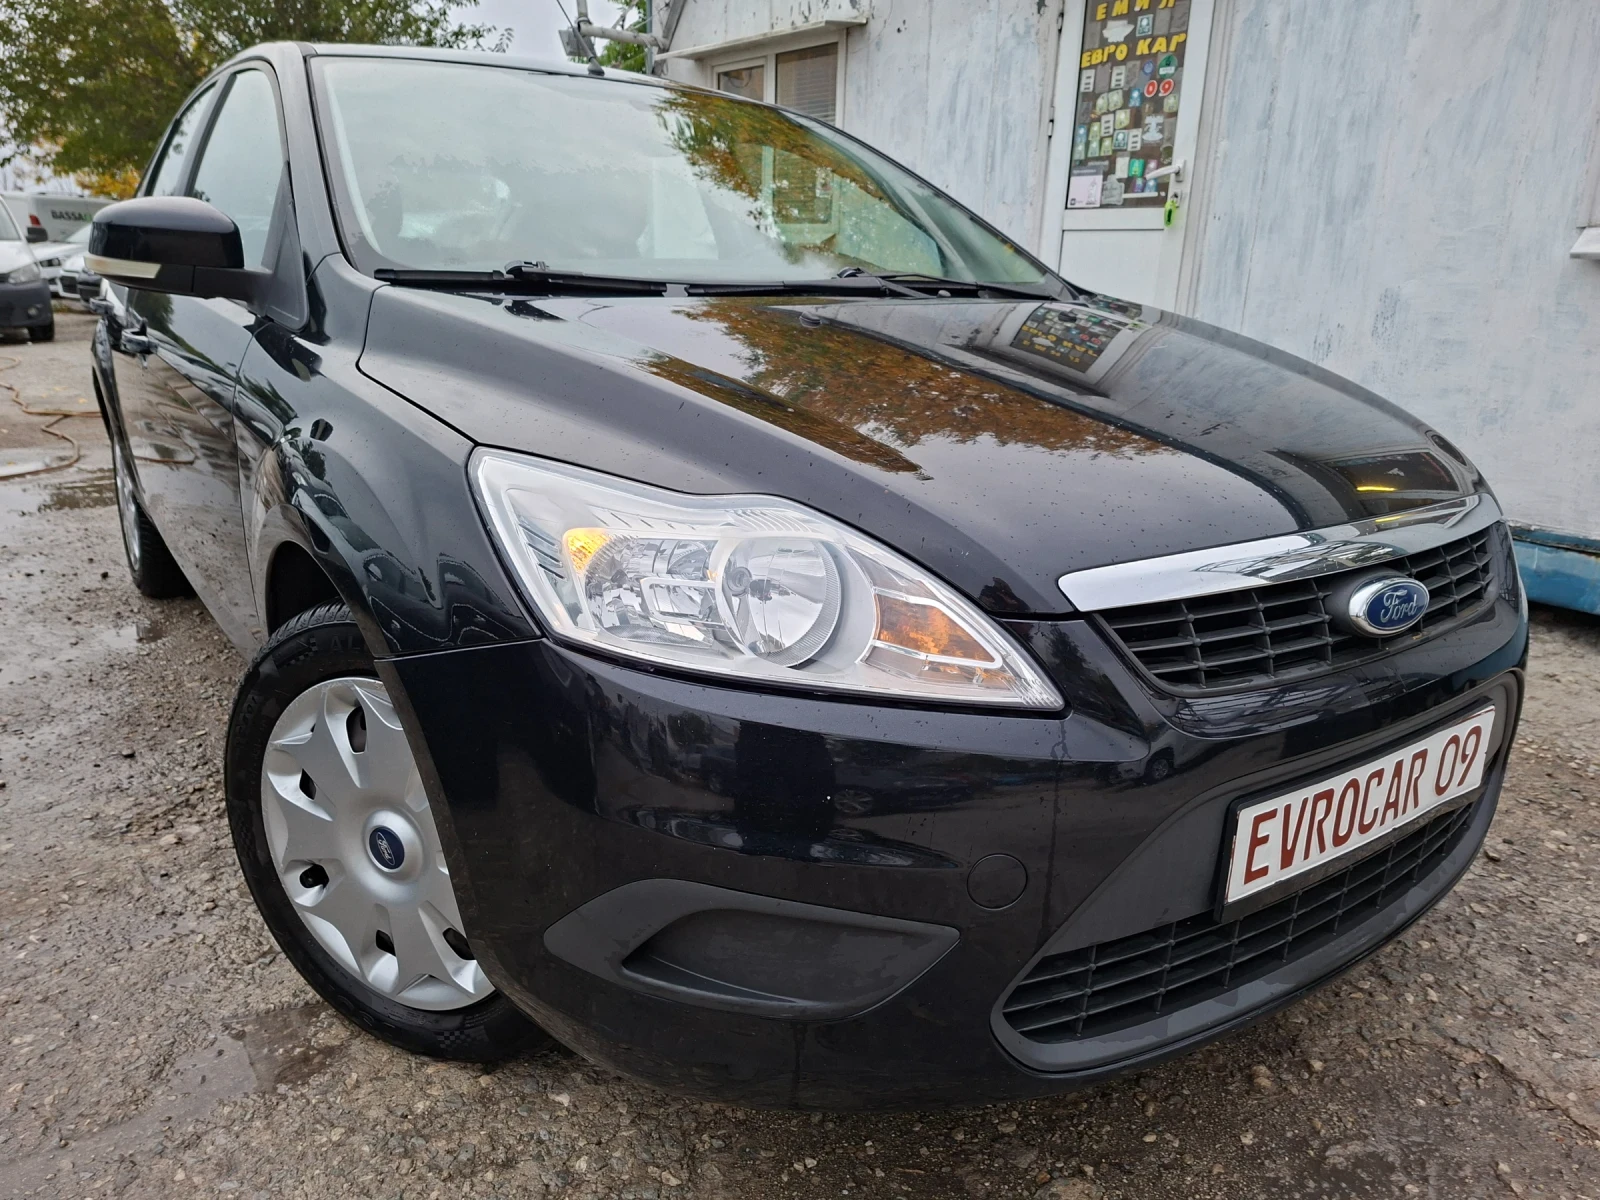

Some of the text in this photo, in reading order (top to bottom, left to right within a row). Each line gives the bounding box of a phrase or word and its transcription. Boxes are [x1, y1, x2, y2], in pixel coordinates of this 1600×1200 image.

[1081, 33, 1187, 68] ЕВРО КАР
[1144, 78, 1174, 98] 09
[1380, 587, 1419, 624] Ford
[1243, 725, 1482, 886] EVROCAR 09
[378, 839, 392, 860] Ford
